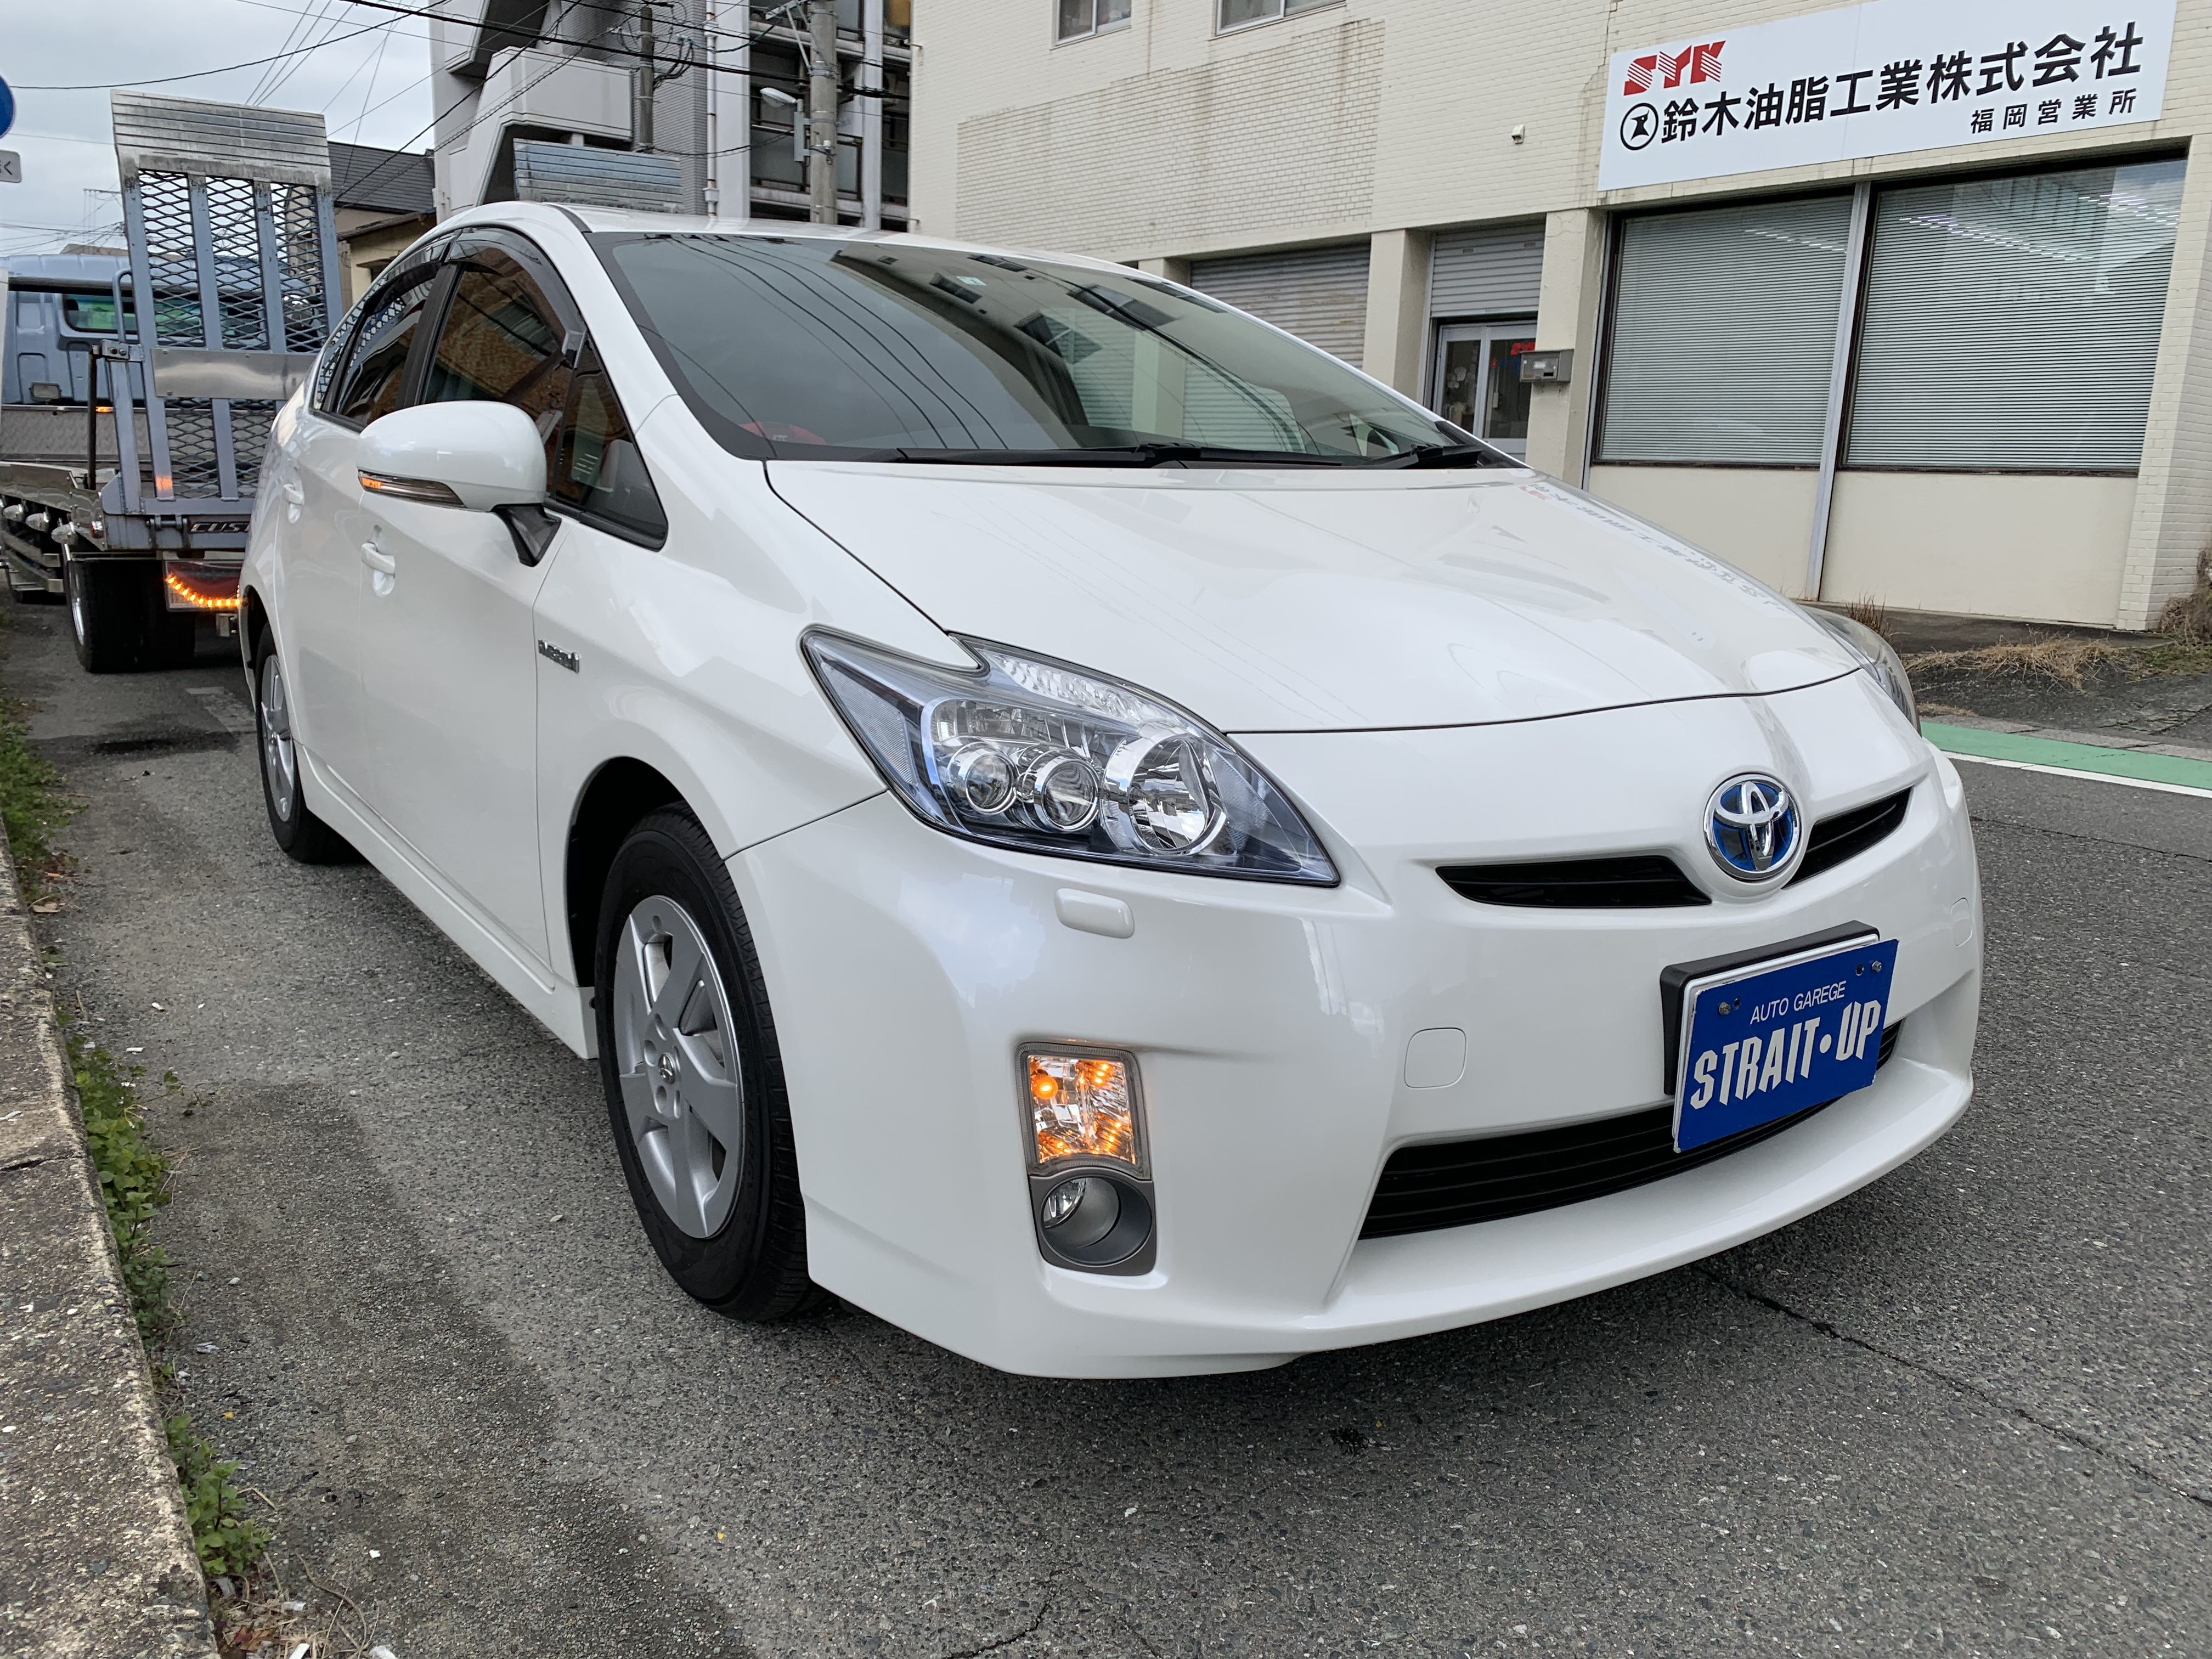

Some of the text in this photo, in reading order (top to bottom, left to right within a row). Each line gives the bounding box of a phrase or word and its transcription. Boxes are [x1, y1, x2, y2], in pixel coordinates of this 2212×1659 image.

[1623, 40, 1726, 96] SYK
[1661, 21, 2143, 144] 鈴木油脂工業株式会社
[1971, 88, 2137, 134] 福岡営業所
[1750, 980, 1847, 1025] AUTO GAREGE
